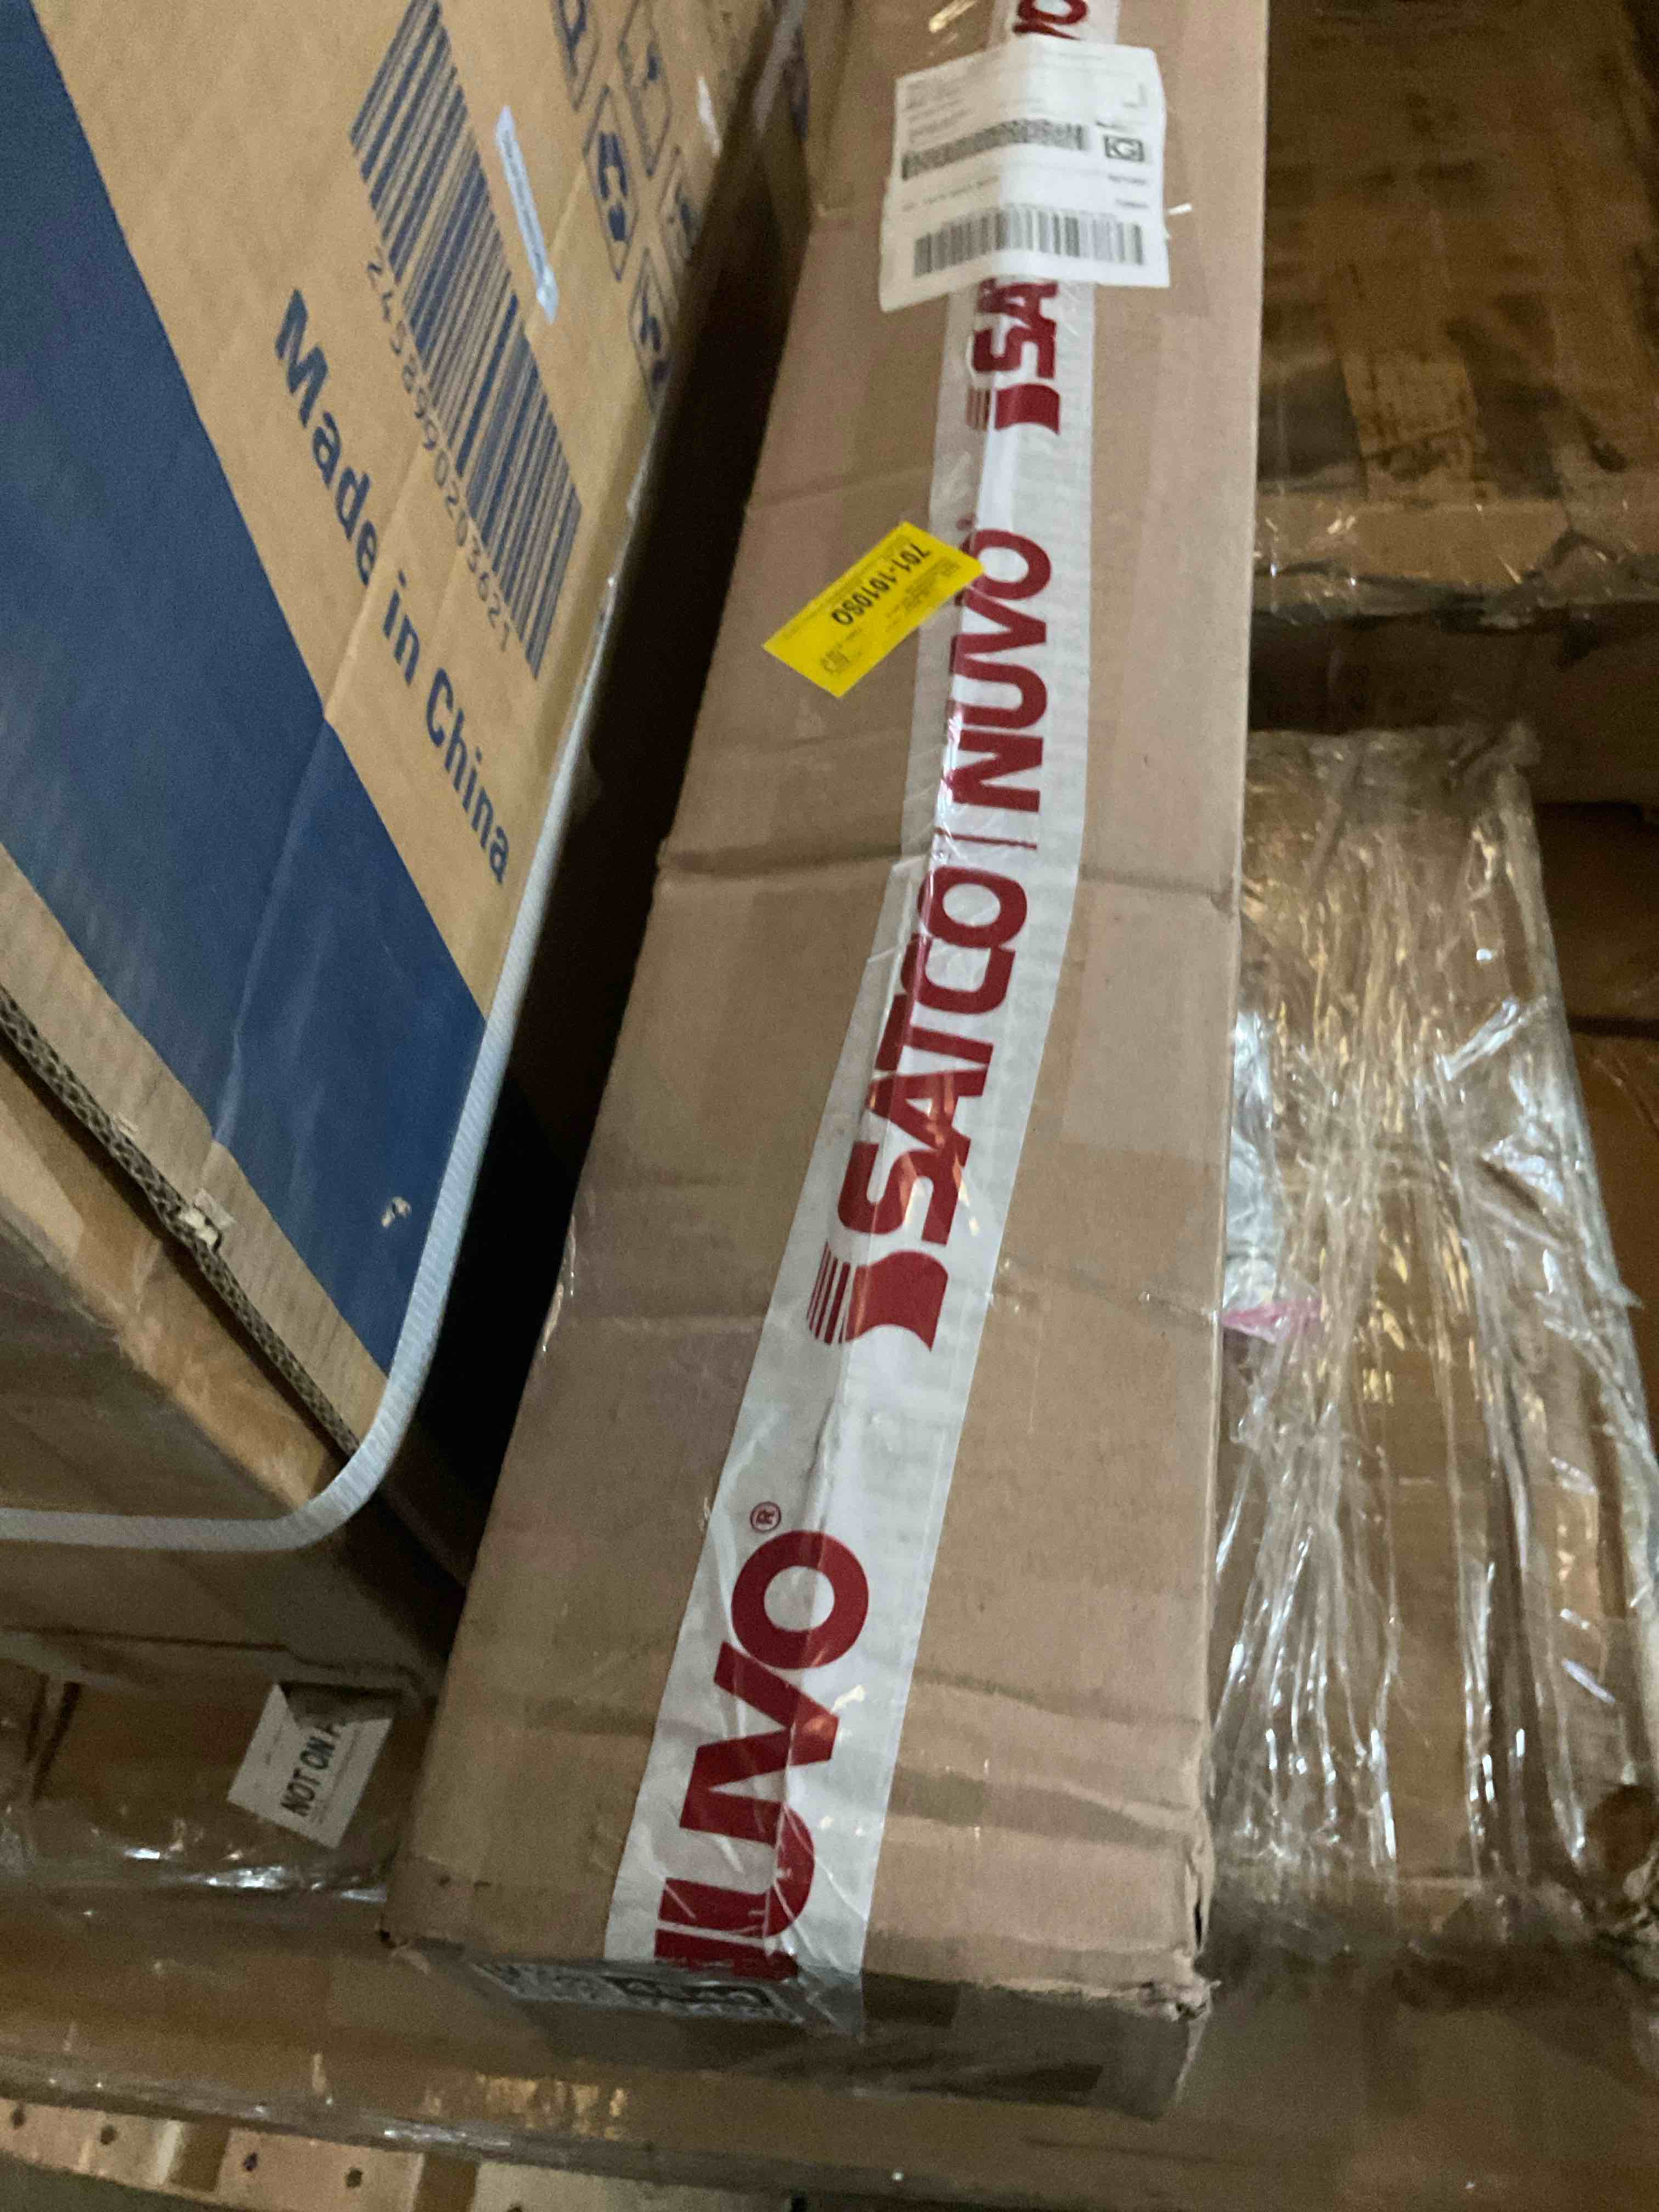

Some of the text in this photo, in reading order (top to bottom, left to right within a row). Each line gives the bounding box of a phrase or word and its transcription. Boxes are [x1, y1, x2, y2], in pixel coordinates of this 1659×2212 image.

[973, 278, 1058, 378] SA
[274, 289, 509, 884] Made in China
[838, 865, 1028, 1245] SATCO
[280, 1768, 321, 1817] NOT
